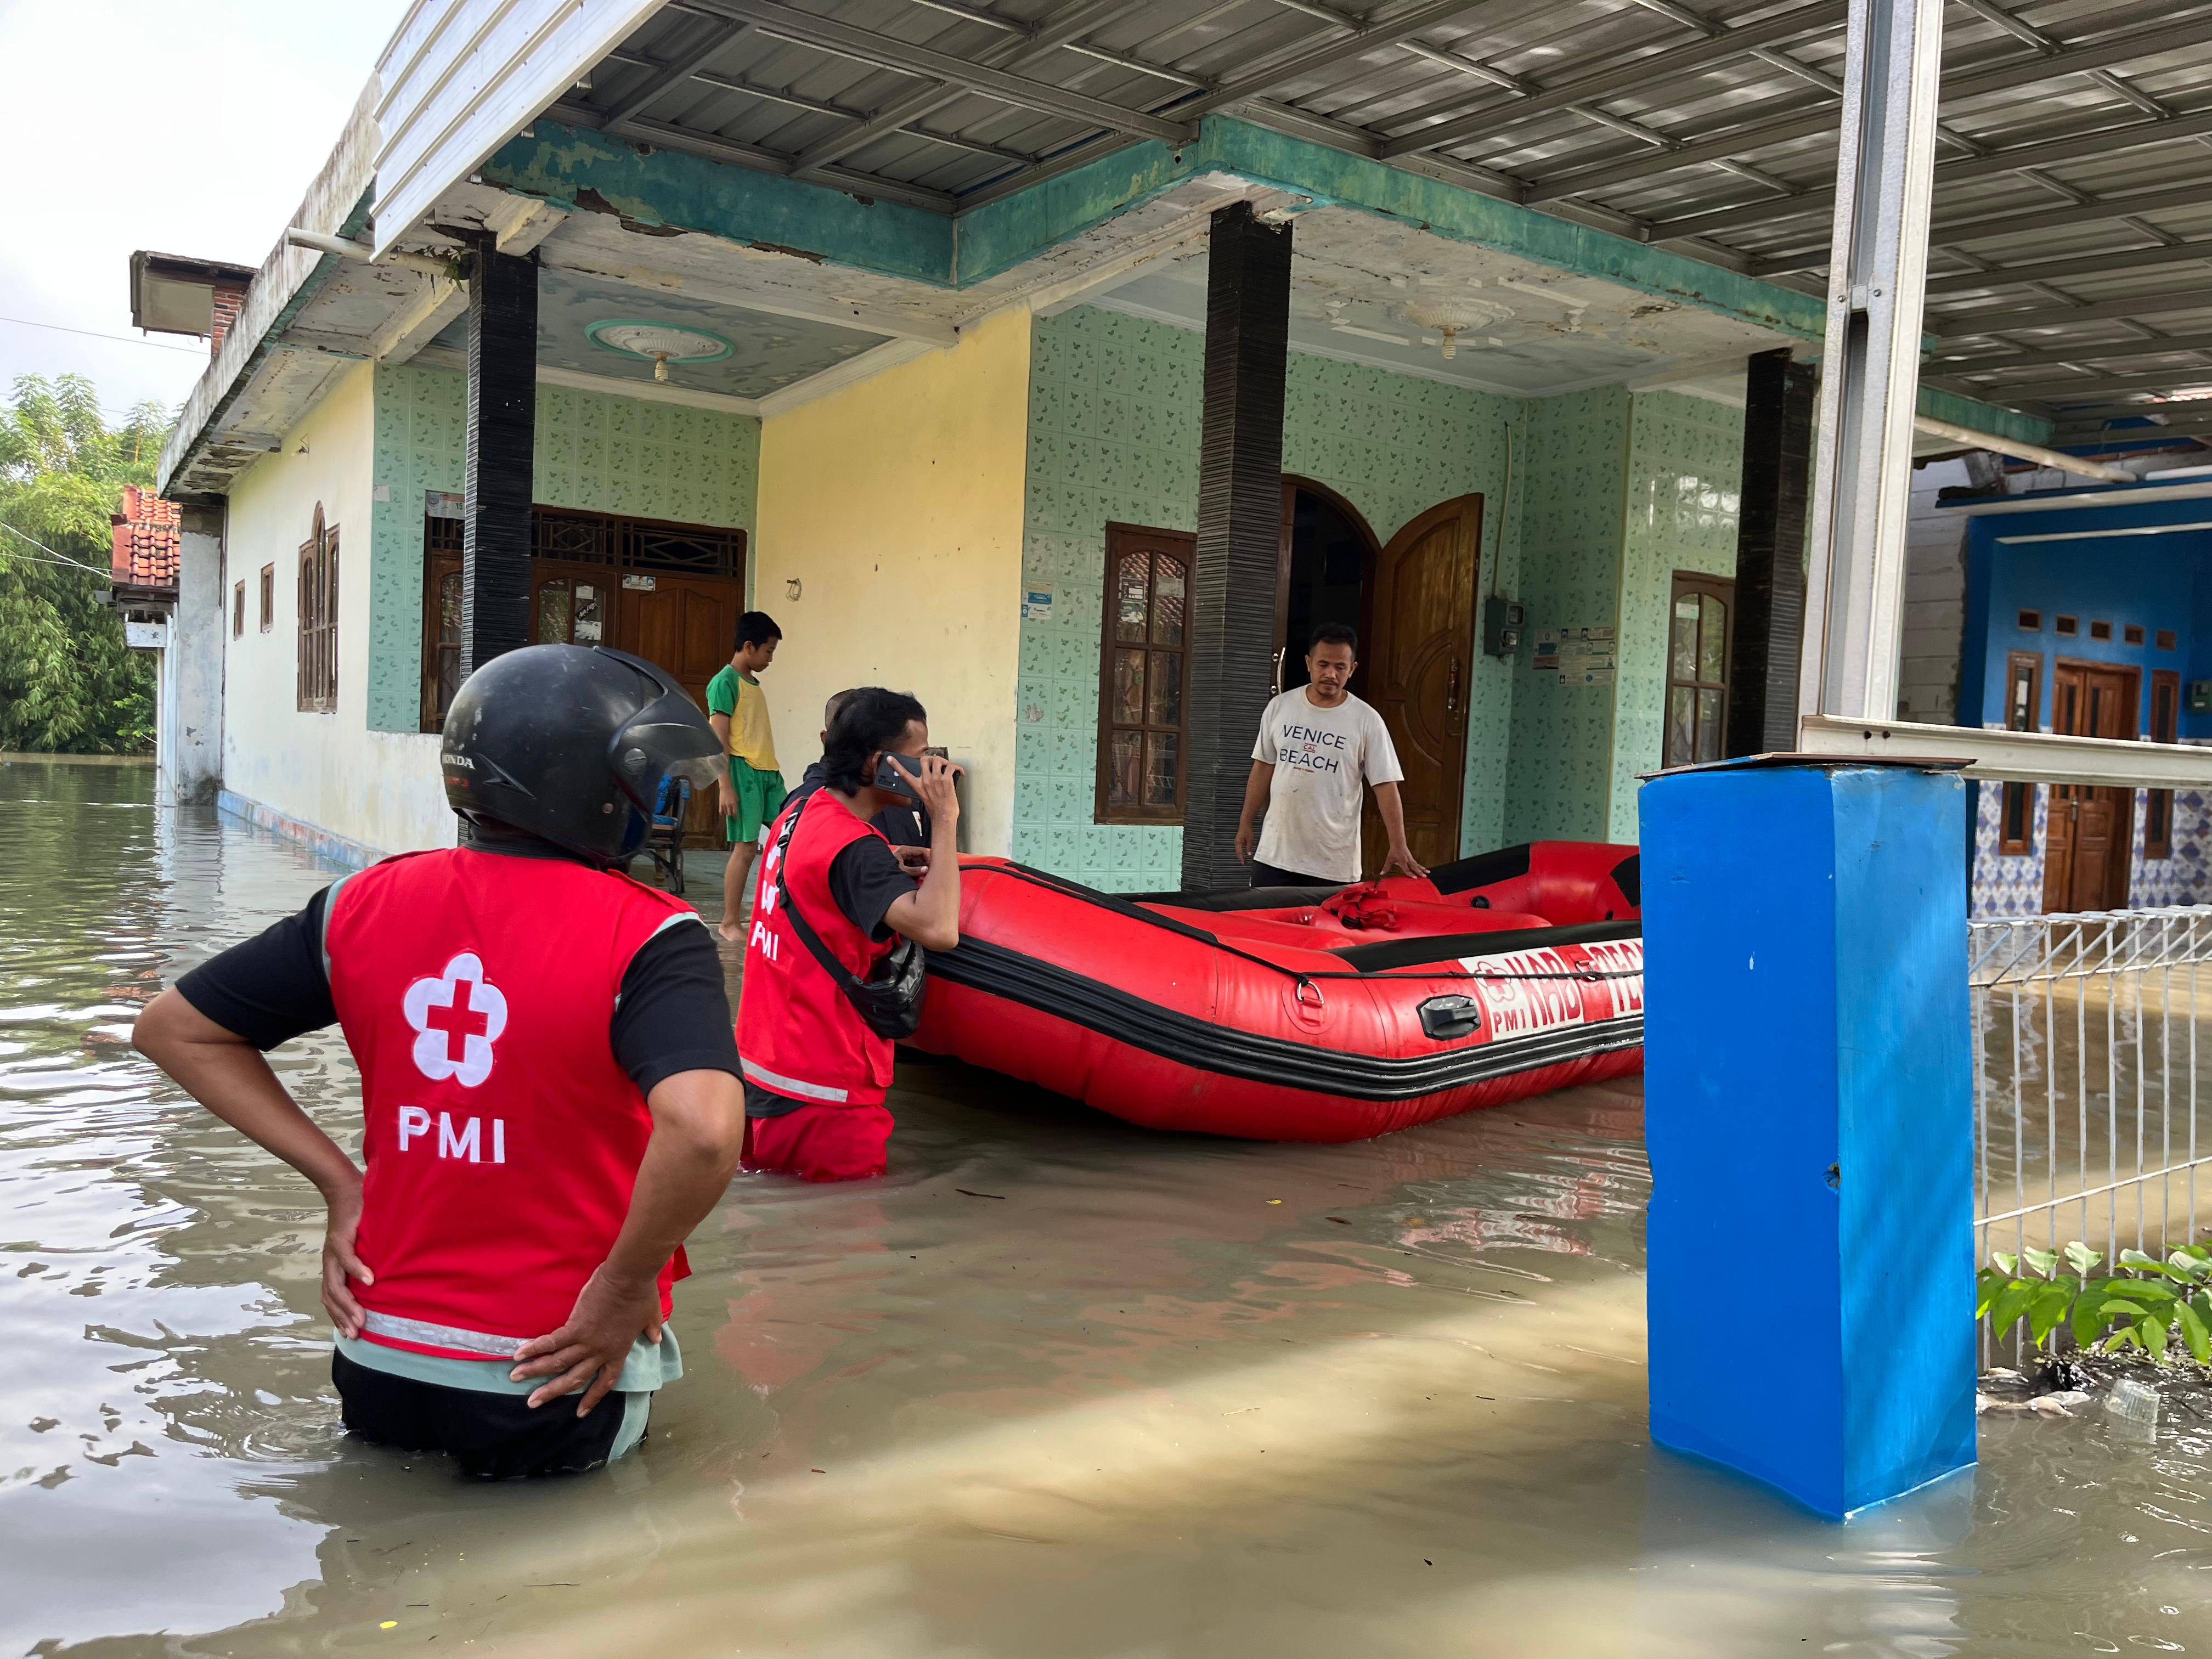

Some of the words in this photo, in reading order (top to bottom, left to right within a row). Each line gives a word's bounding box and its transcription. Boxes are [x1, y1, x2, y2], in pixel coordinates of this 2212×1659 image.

[1284, 725, 1346, 750] VENICE
[1280, 749, 1339, 773] BEACH
[1504, 952, 1581, 1028] KAB
[1493, 1009, 1526, 1033] PMI
[399, 1105, 505, 1163] PMI
